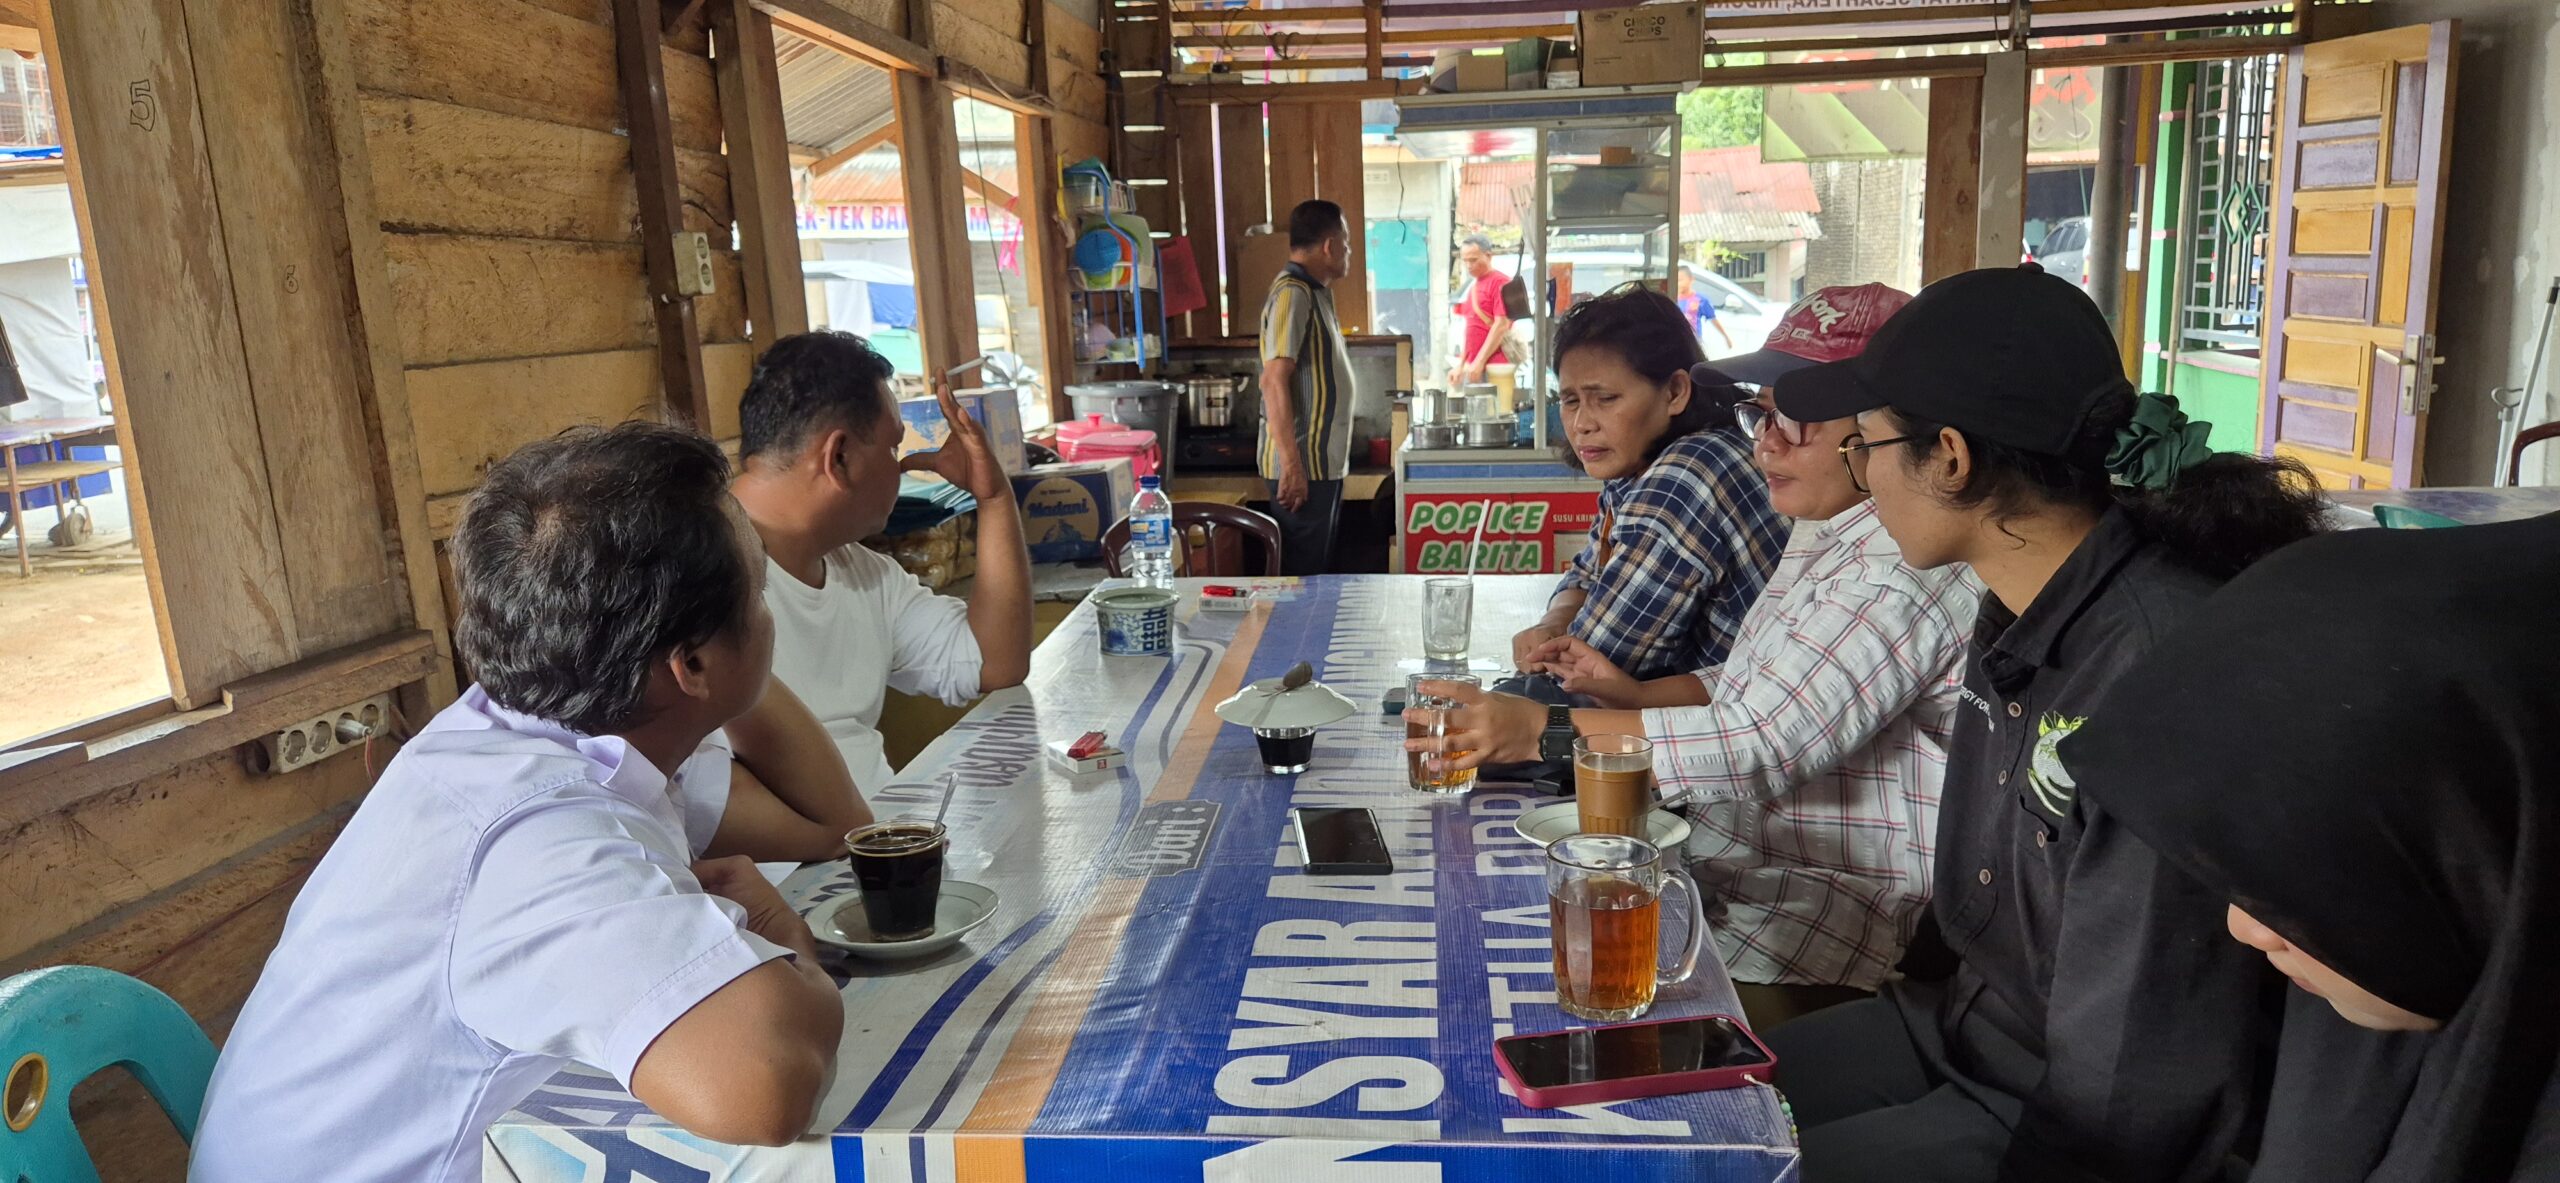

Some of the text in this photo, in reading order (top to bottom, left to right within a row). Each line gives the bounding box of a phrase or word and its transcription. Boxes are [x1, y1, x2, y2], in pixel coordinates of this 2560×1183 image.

[1624, 16, 1665, 27] CCO
[129, 78, 156, 132] 5
[1407, 501, 1549, 534] POP ICE
[1552, 514, 1573, 523] SUSU
[1417, 540, 1542, 573] BARITA
